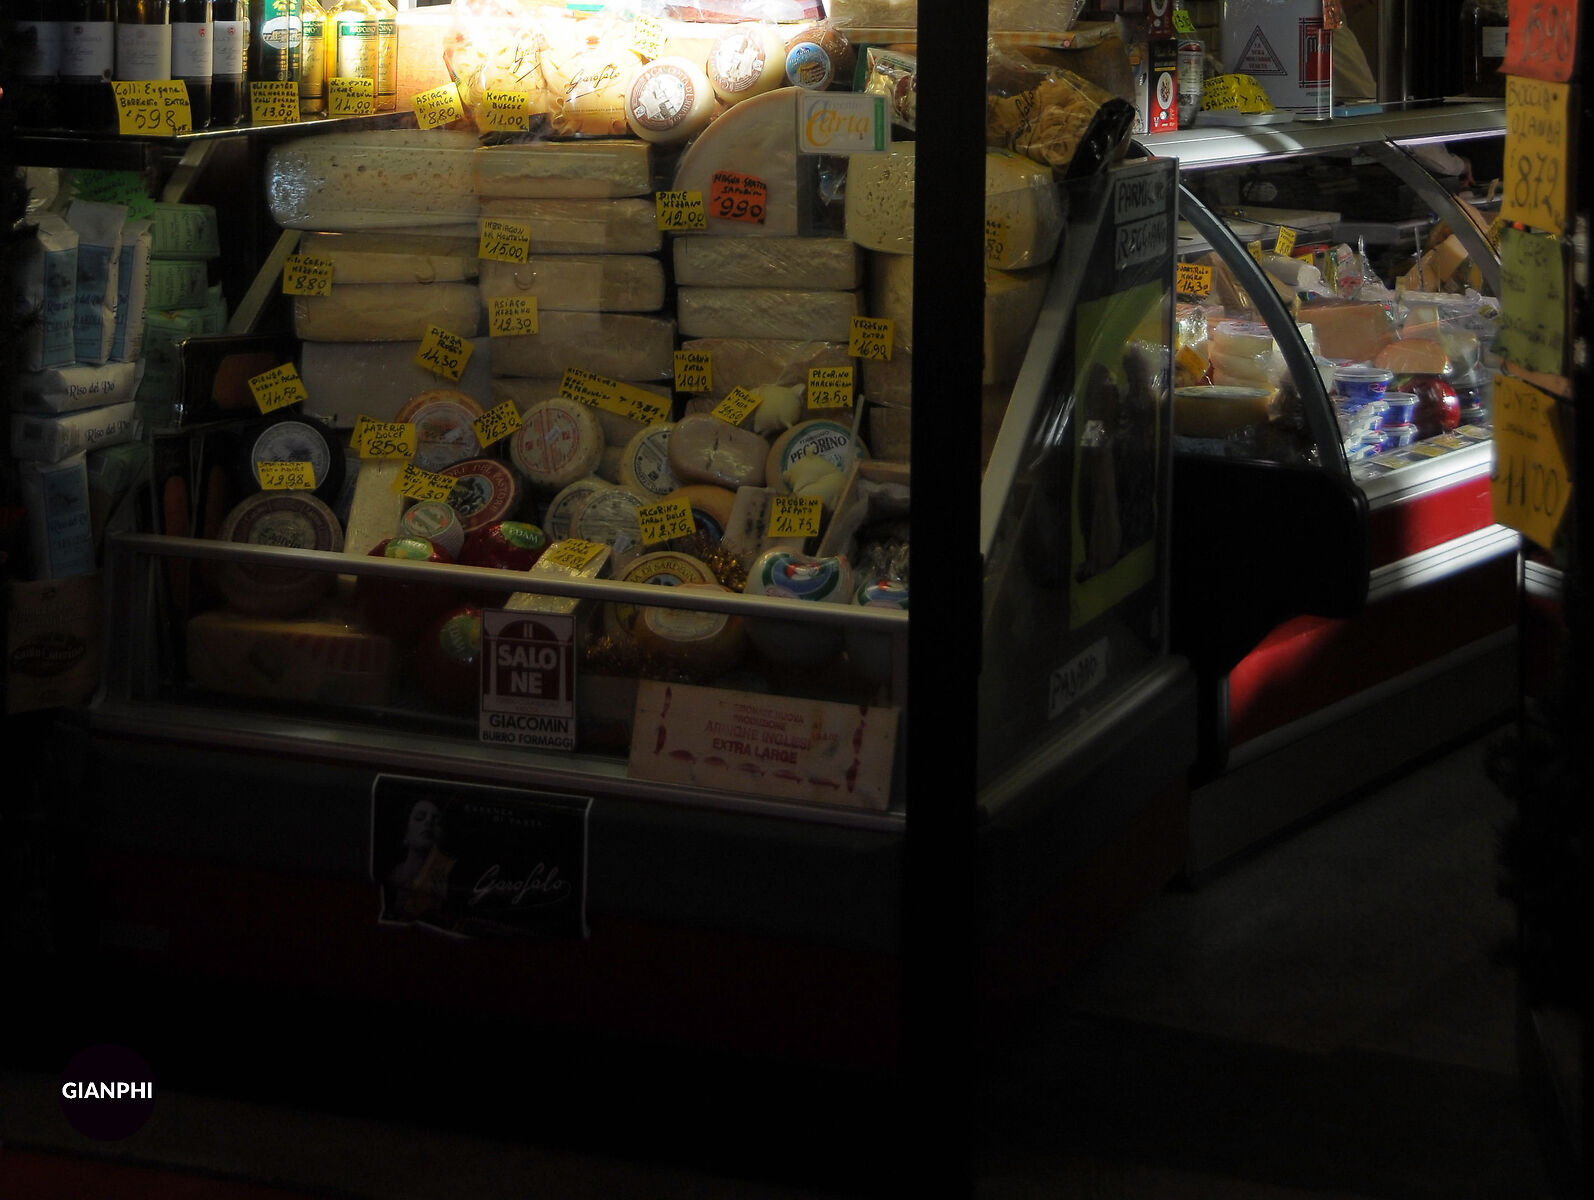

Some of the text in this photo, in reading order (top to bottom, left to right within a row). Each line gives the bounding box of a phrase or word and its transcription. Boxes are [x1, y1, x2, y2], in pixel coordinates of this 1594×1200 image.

[499, 643, 557, 671] SALO
[510, 672, 546, 696] NE
[488, 712, 570, 735] GIACOMIN
[482, 729, 574, 750] BURRO FORMAGGI
[713, 737, 798, 765] EXTRA LARGE
